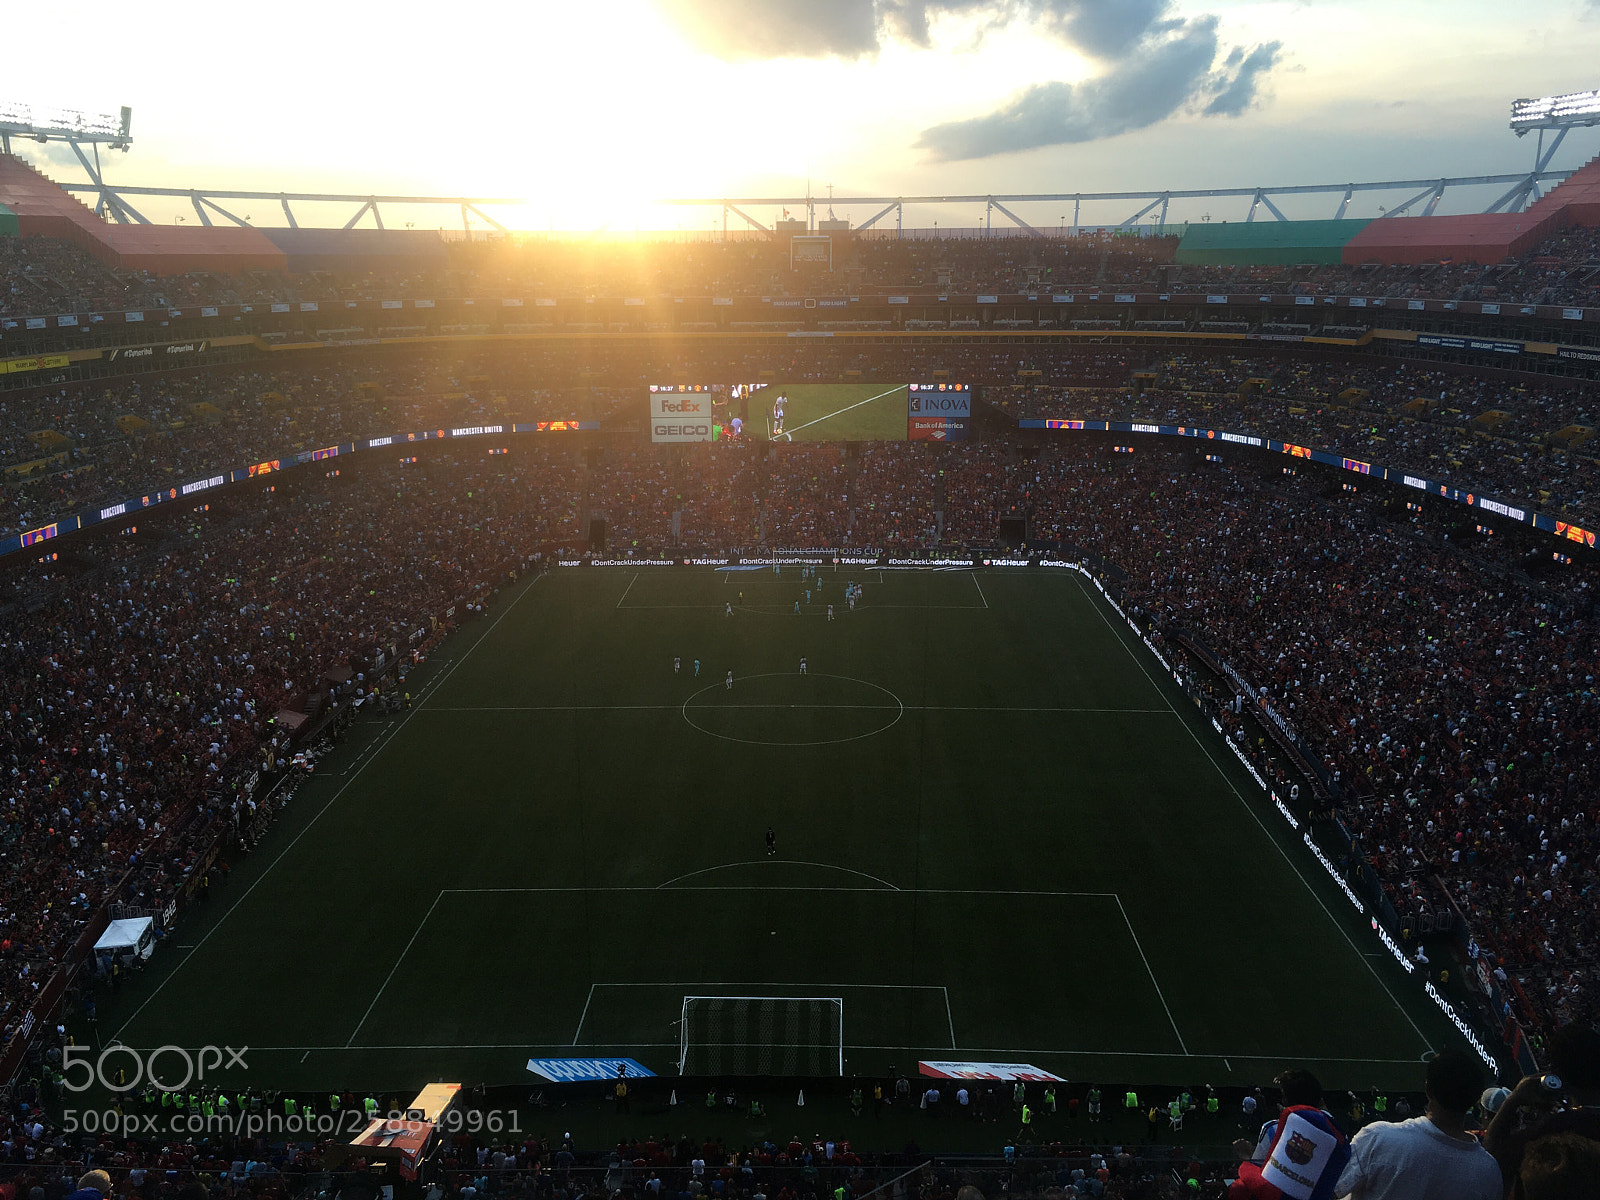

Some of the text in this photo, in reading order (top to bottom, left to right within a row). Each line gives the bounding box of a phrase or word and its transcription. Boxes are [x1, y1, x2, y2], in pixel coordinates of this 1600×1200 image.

[662, 400, 700, 412] FedEx
[925, 400, 968, 410] INOVA
[452, 425, 503, 436] MANCHESTER UNITED
[654, 425, 708, 436] GEICO
[1132, 424, 1159, 433] BARCELONA
[370, 436, 392, 447] BARCELONA
[1304, 832, 1364, 914] #DontCrackUnderPressure
